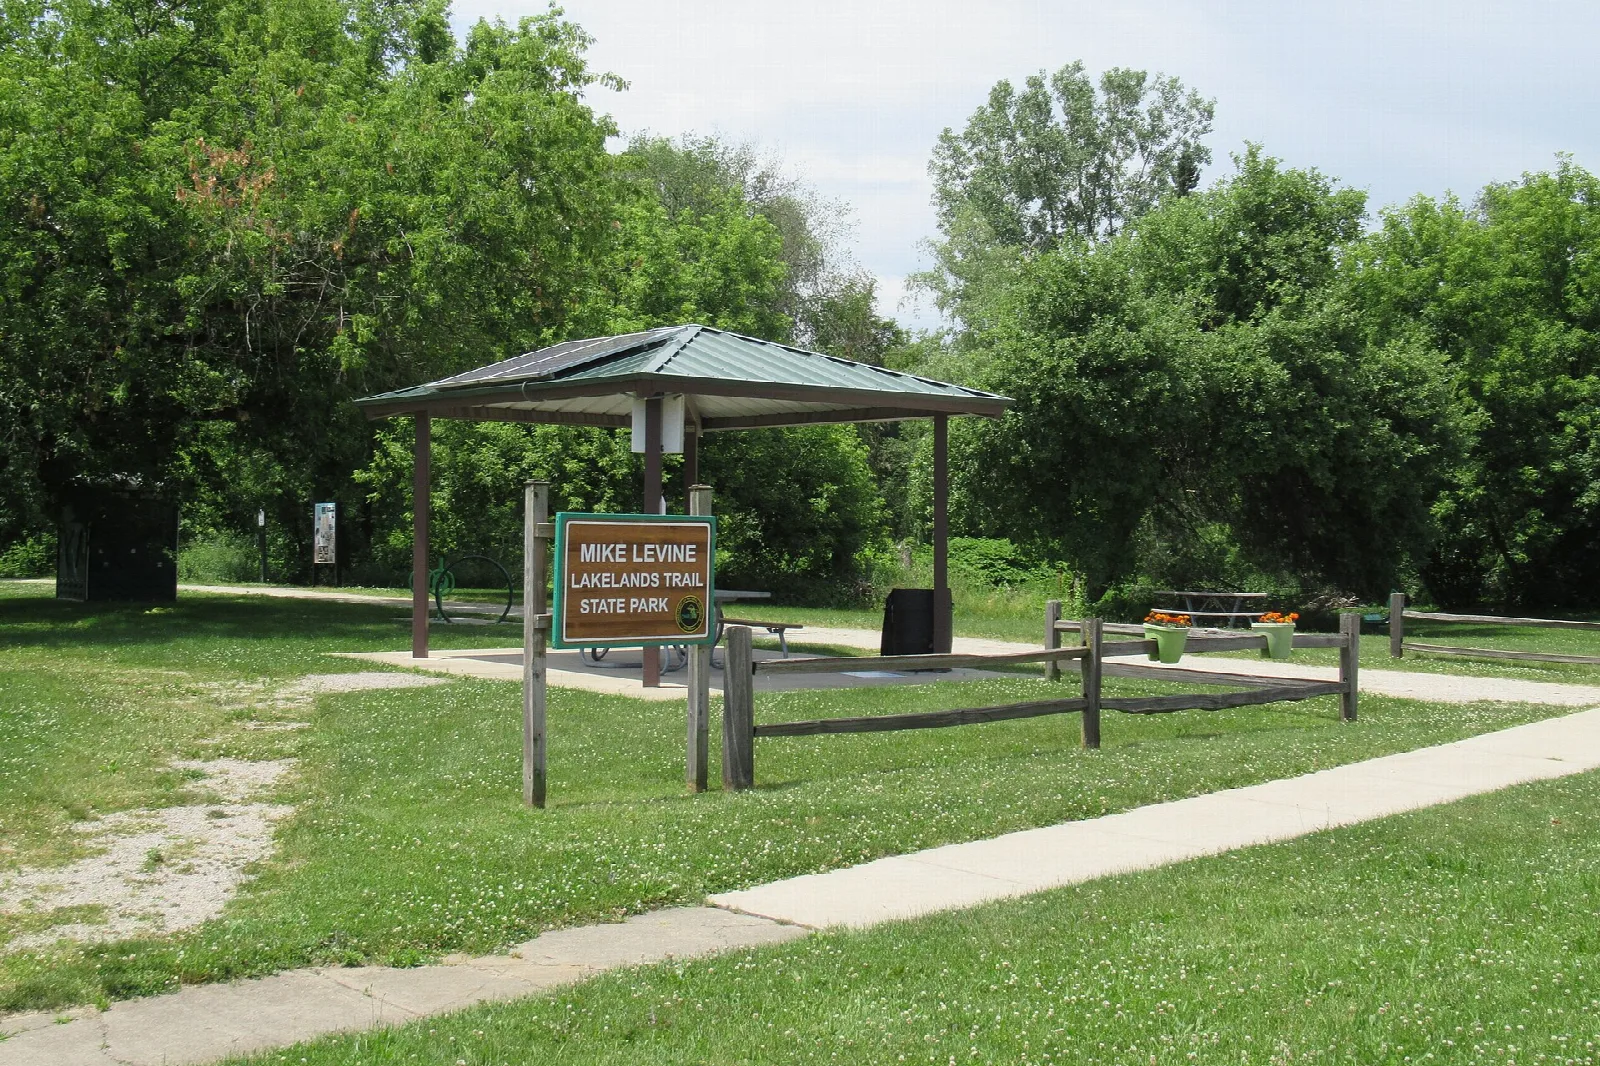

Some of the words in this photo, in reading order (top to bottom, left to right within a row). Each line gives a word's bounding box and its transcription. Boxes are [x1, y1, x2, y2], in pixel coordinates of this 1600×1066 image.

[581, 544, 627, 563] MIKE
[633, 544, 696, 563] LEVINE
[571, 573, 660, 588] LAKELANDS
[664, 573, 704, 587] TRAIL
[580, 599, 625, 614] STATE
[630, 598, 669, 613] PARK
